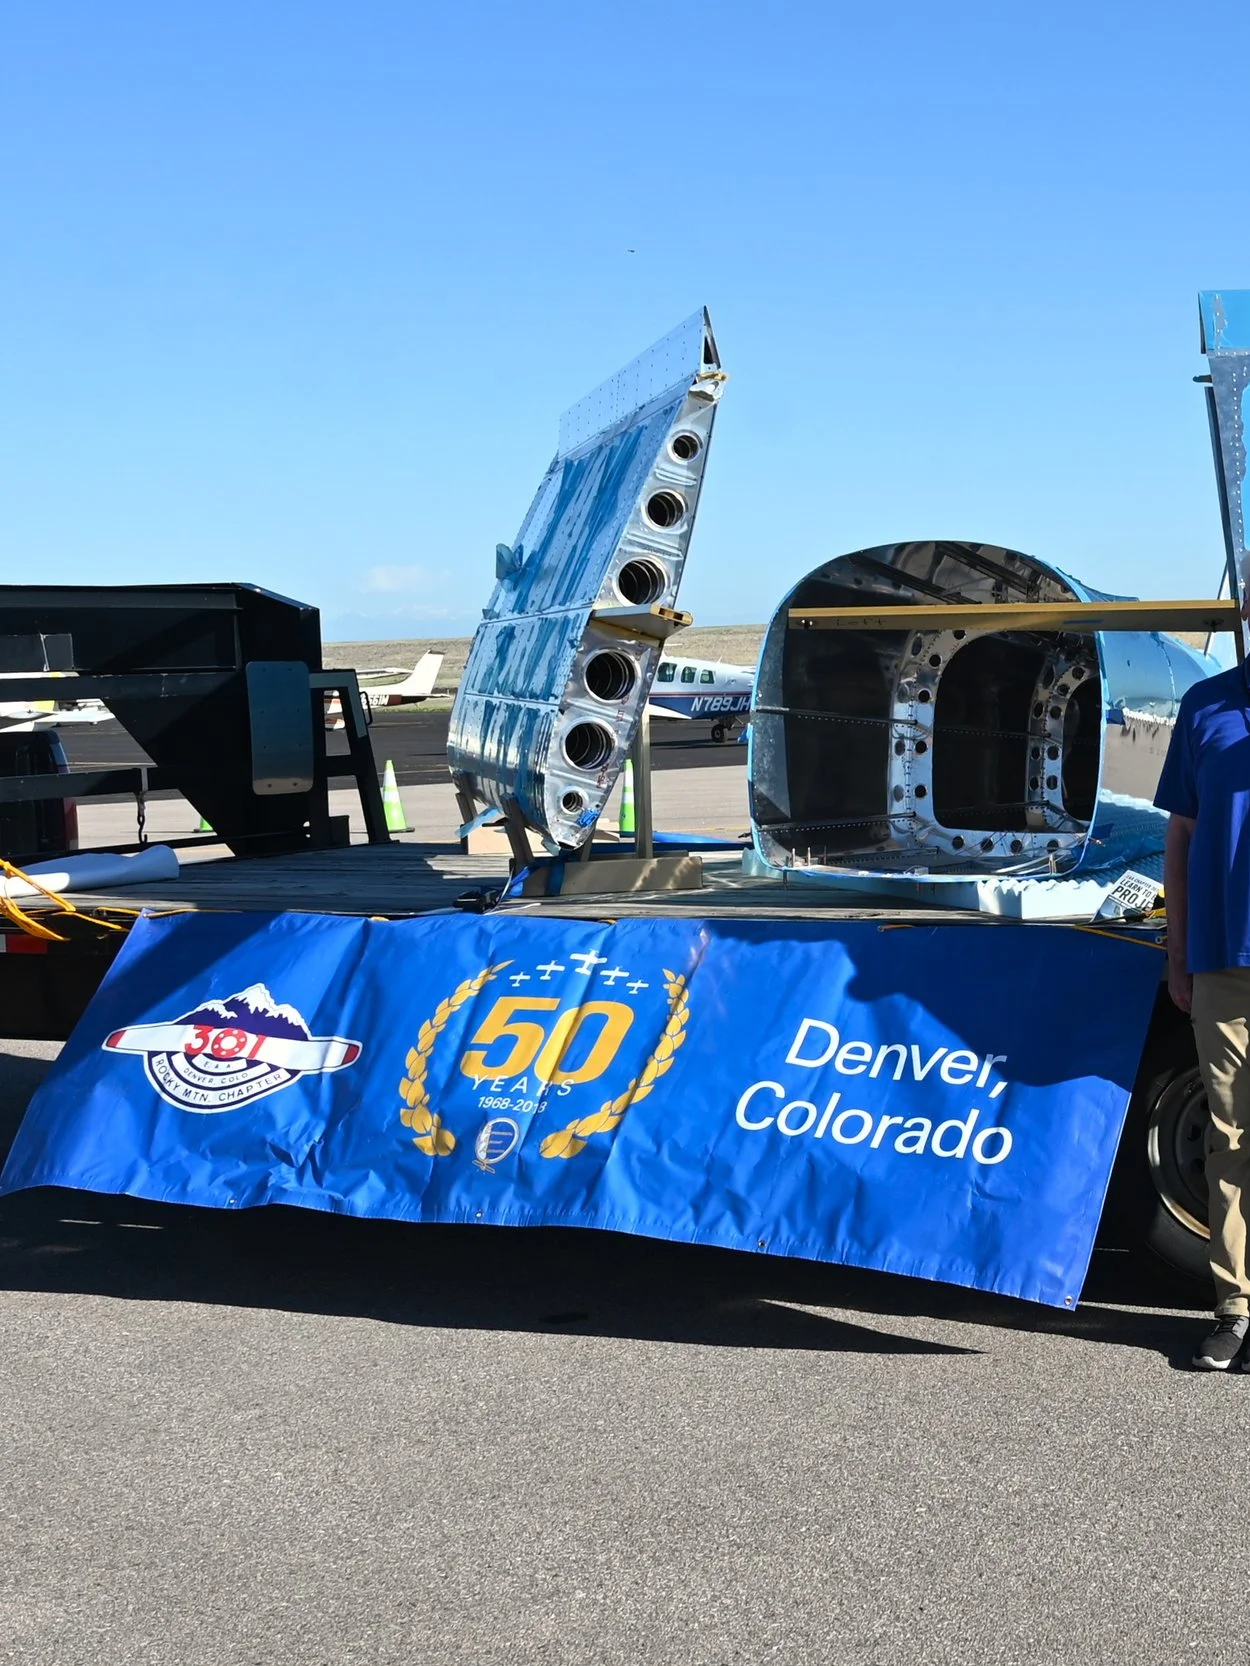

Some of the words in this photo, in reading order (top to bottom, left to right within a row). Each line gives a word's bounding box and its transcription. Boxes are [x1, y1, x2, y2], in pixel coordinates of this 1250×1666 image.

[691, 696, 752, 712] N789JH
[1119, 879, 1143, 893] LEARN
[1143, 888, 1152, 898] TO
[185, 1024, 267, 1060] 301
[460, 996, 635, 1085] 50
[785, 1017, 1008, 1098] Denver,
[156, 1058, 180, 1090] ROCKY
[218, 1073, 283, 1102] CHAPTER
[472, 1074, 575, 1097] YEARS
[735, 1080, 1013, 1165] Colorado
